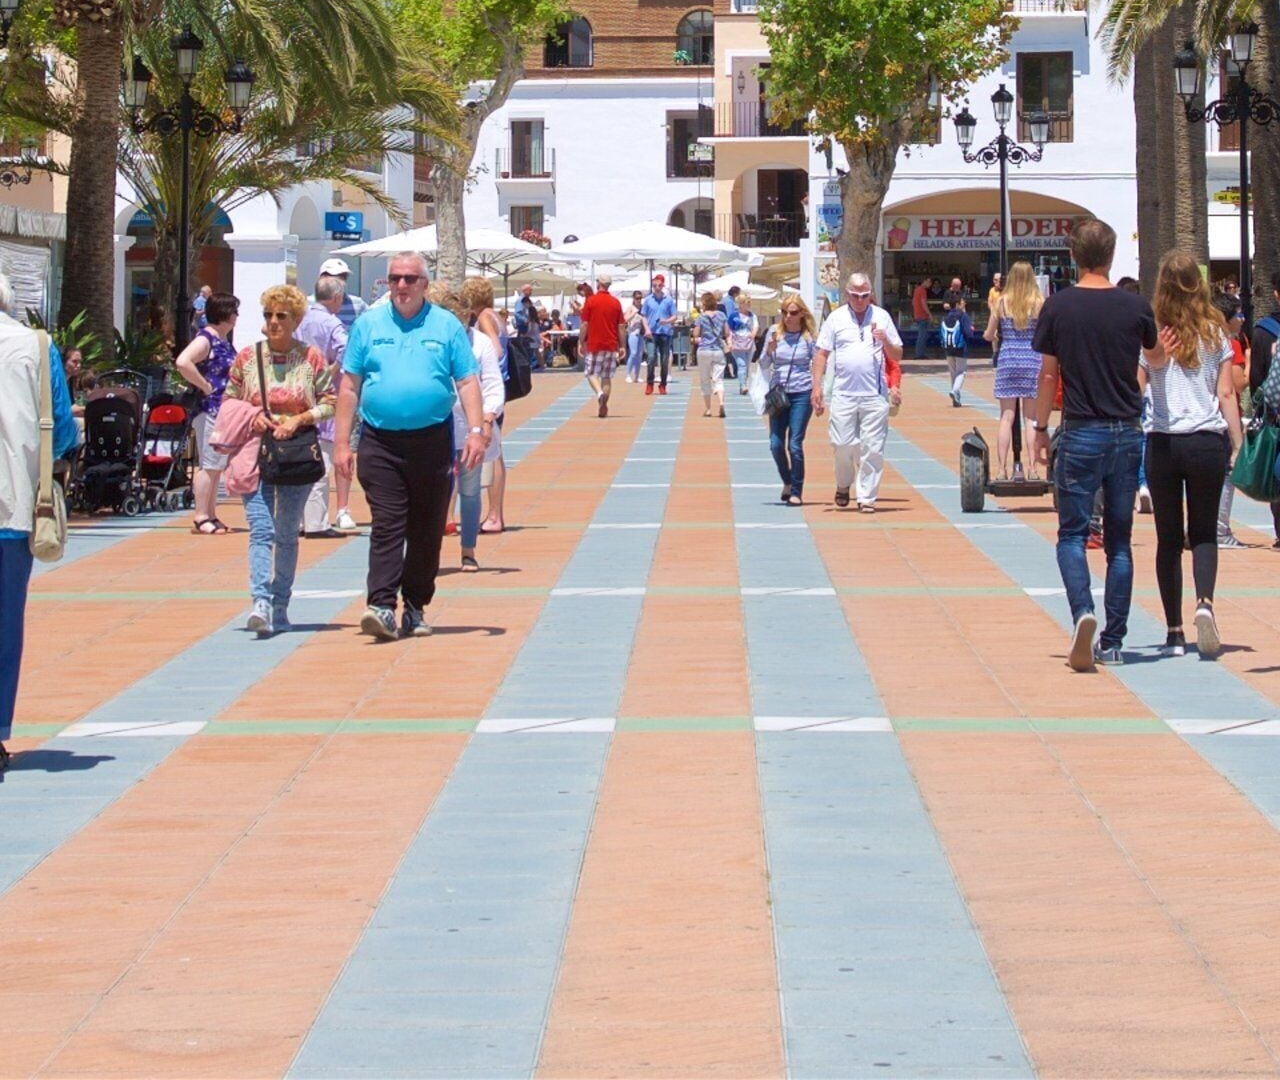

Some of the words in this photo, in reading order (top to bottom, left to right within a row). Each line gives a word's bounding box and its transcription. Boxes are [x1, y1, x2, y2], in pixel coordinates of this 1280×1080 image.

[920, 217, 1072, 238] HELADER
[914, 239, 953, 249] HELADOS
[1016, 239, 1041, 249] HOME
[1044, 239, 1069, 249] MAD
